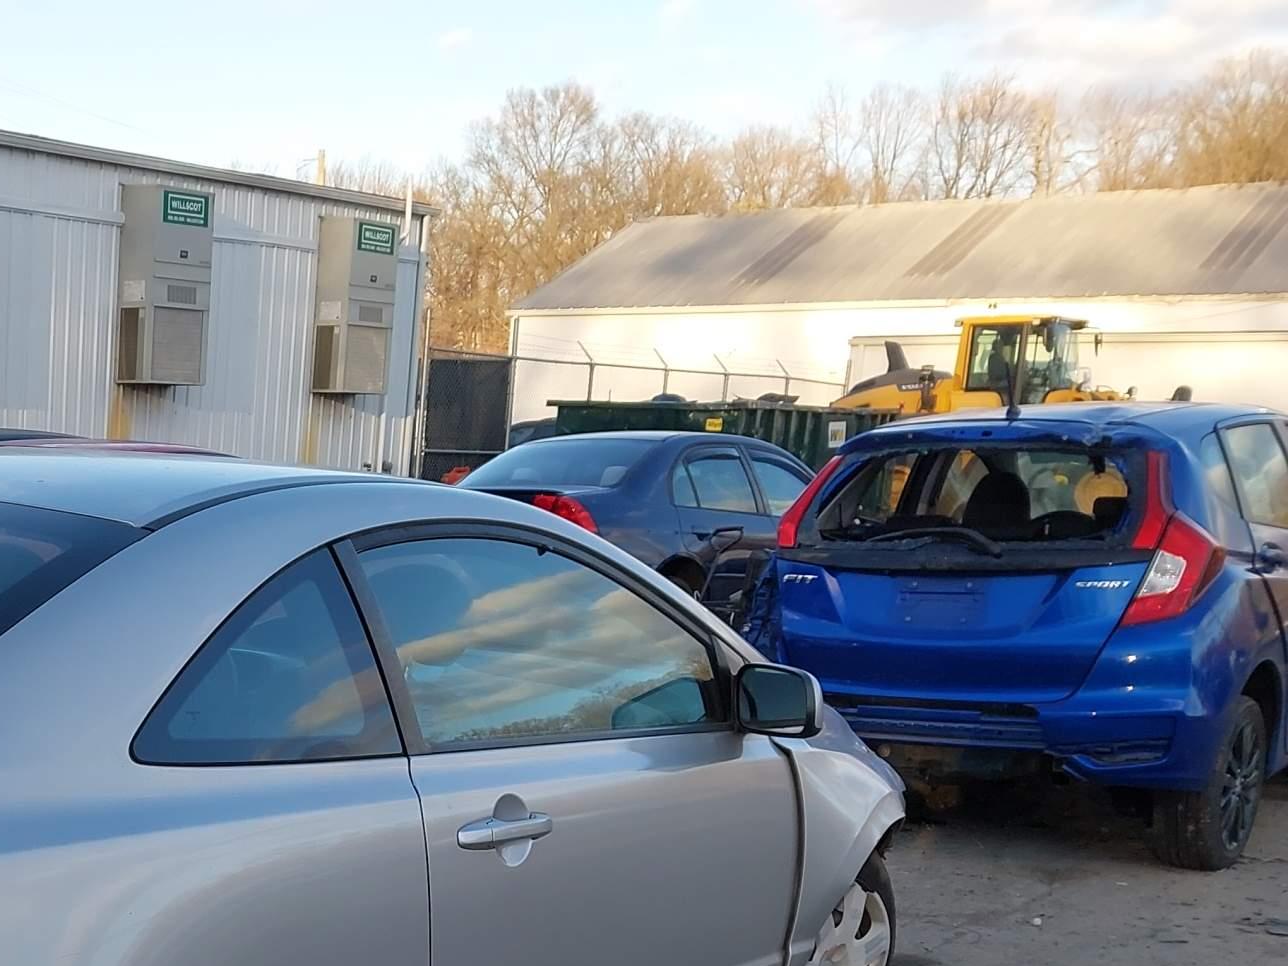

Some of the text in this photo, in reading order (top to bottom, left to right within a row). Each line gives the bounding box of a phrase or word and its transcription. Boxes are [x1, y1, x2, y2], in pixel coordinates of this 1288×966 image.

[171, 199, 202, 212] WILLSCOT
[782, 573, 819, 584] FIT
[1075, 580, 1131, 588] SPORT
